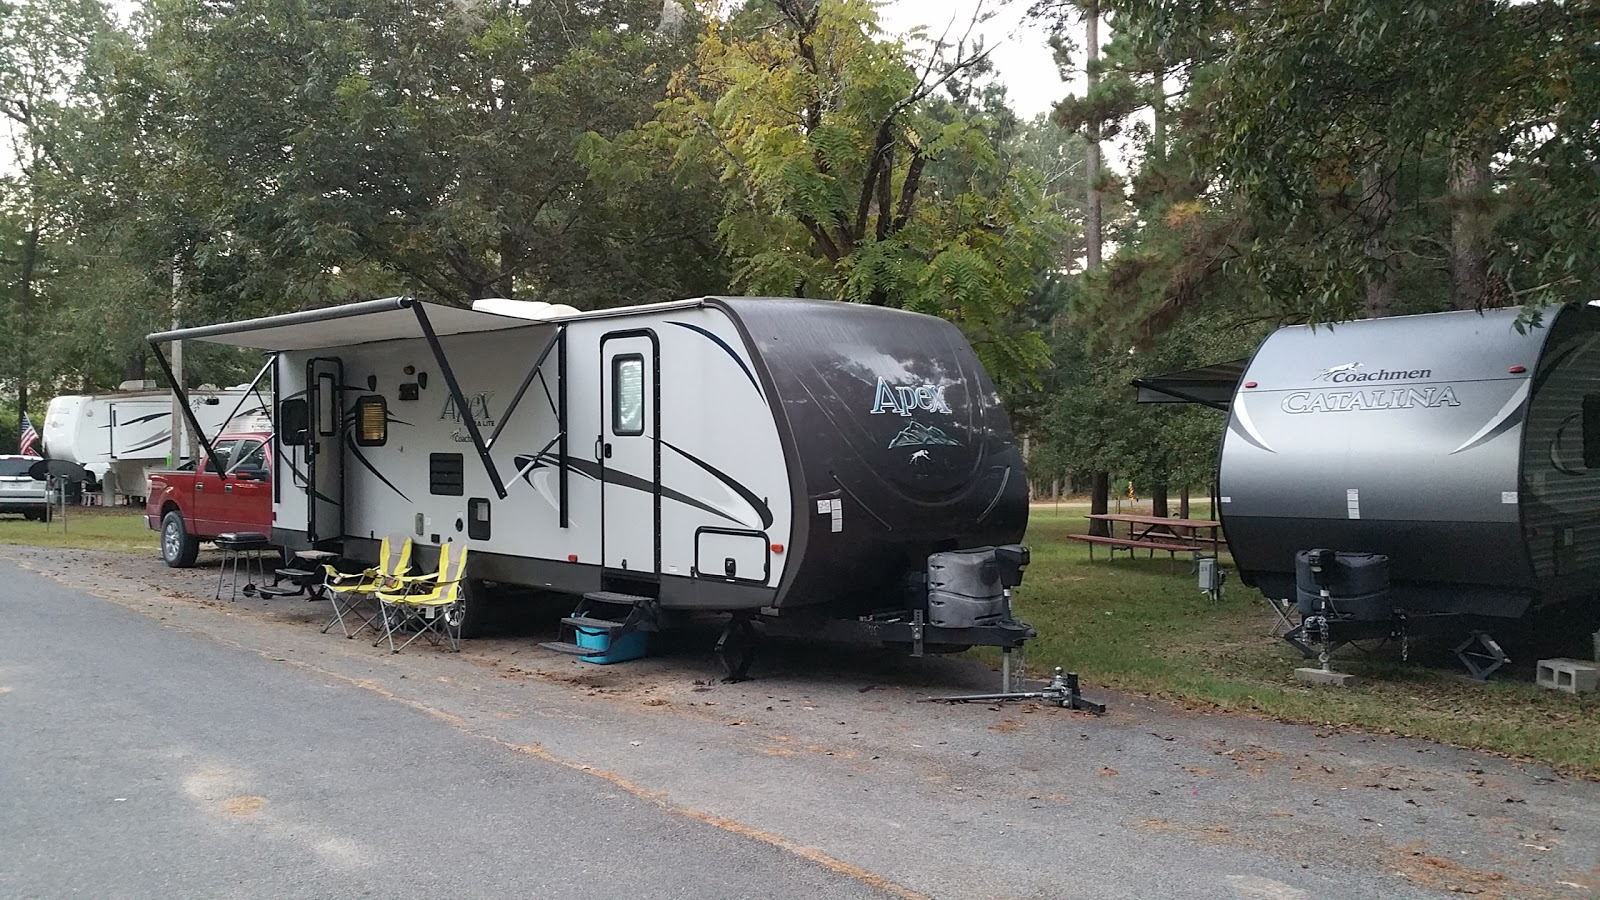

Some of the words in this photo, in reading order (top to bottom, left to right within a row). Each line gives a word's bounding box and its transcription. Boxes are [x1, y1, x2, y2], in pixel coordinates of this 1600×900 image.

[1332, 369, 1432, 383] Coachmen
[870, 376, 953, 417] Apex
[1281, 386, 1461, 414] CATALINA
